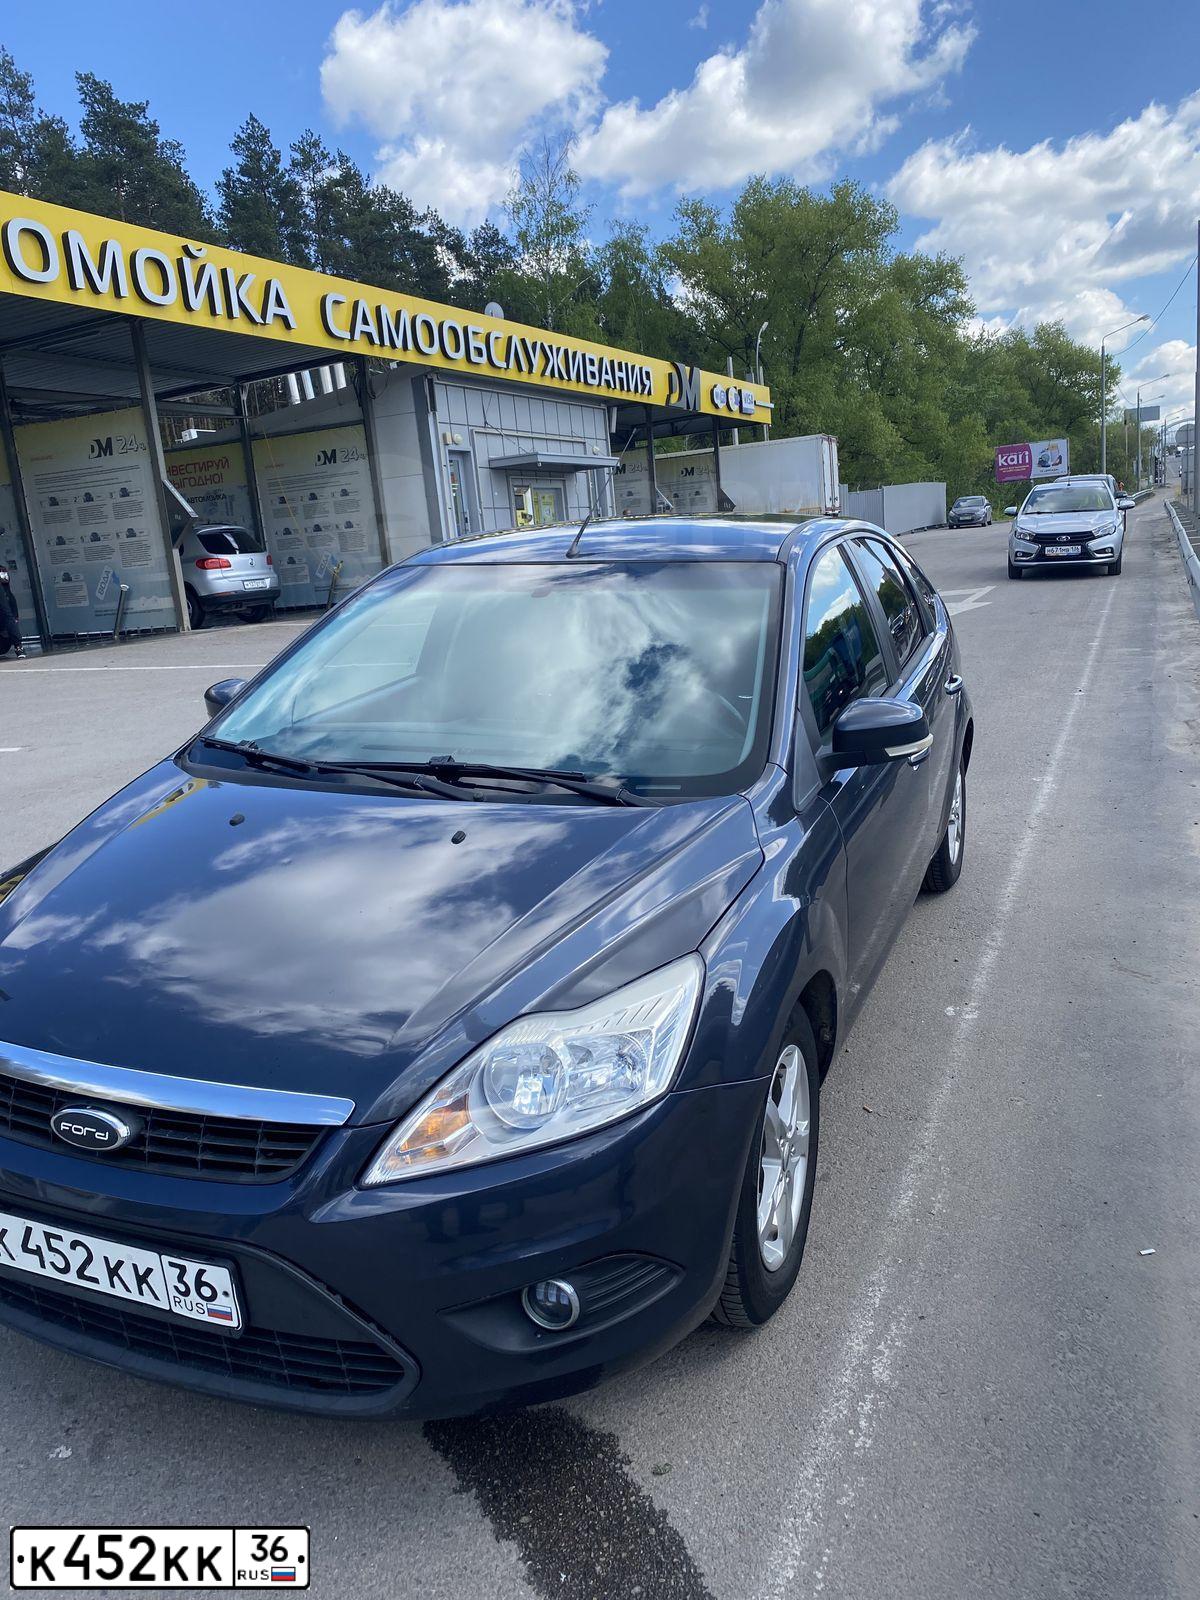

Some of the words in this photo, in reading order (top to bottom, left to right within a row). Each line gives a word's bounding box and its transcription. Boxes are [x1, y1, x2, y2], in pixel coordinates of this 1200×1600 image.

[321, 292, 653, 396] САМООБСЛУЖИВАНИЯ
[166, 456, 230, 476] НВЕСТИРУЙ
[998, 450, 1029, 467] kari
[165, 1261, 218, 1303] 36
[173, 1296, 206, 1316] RUS
